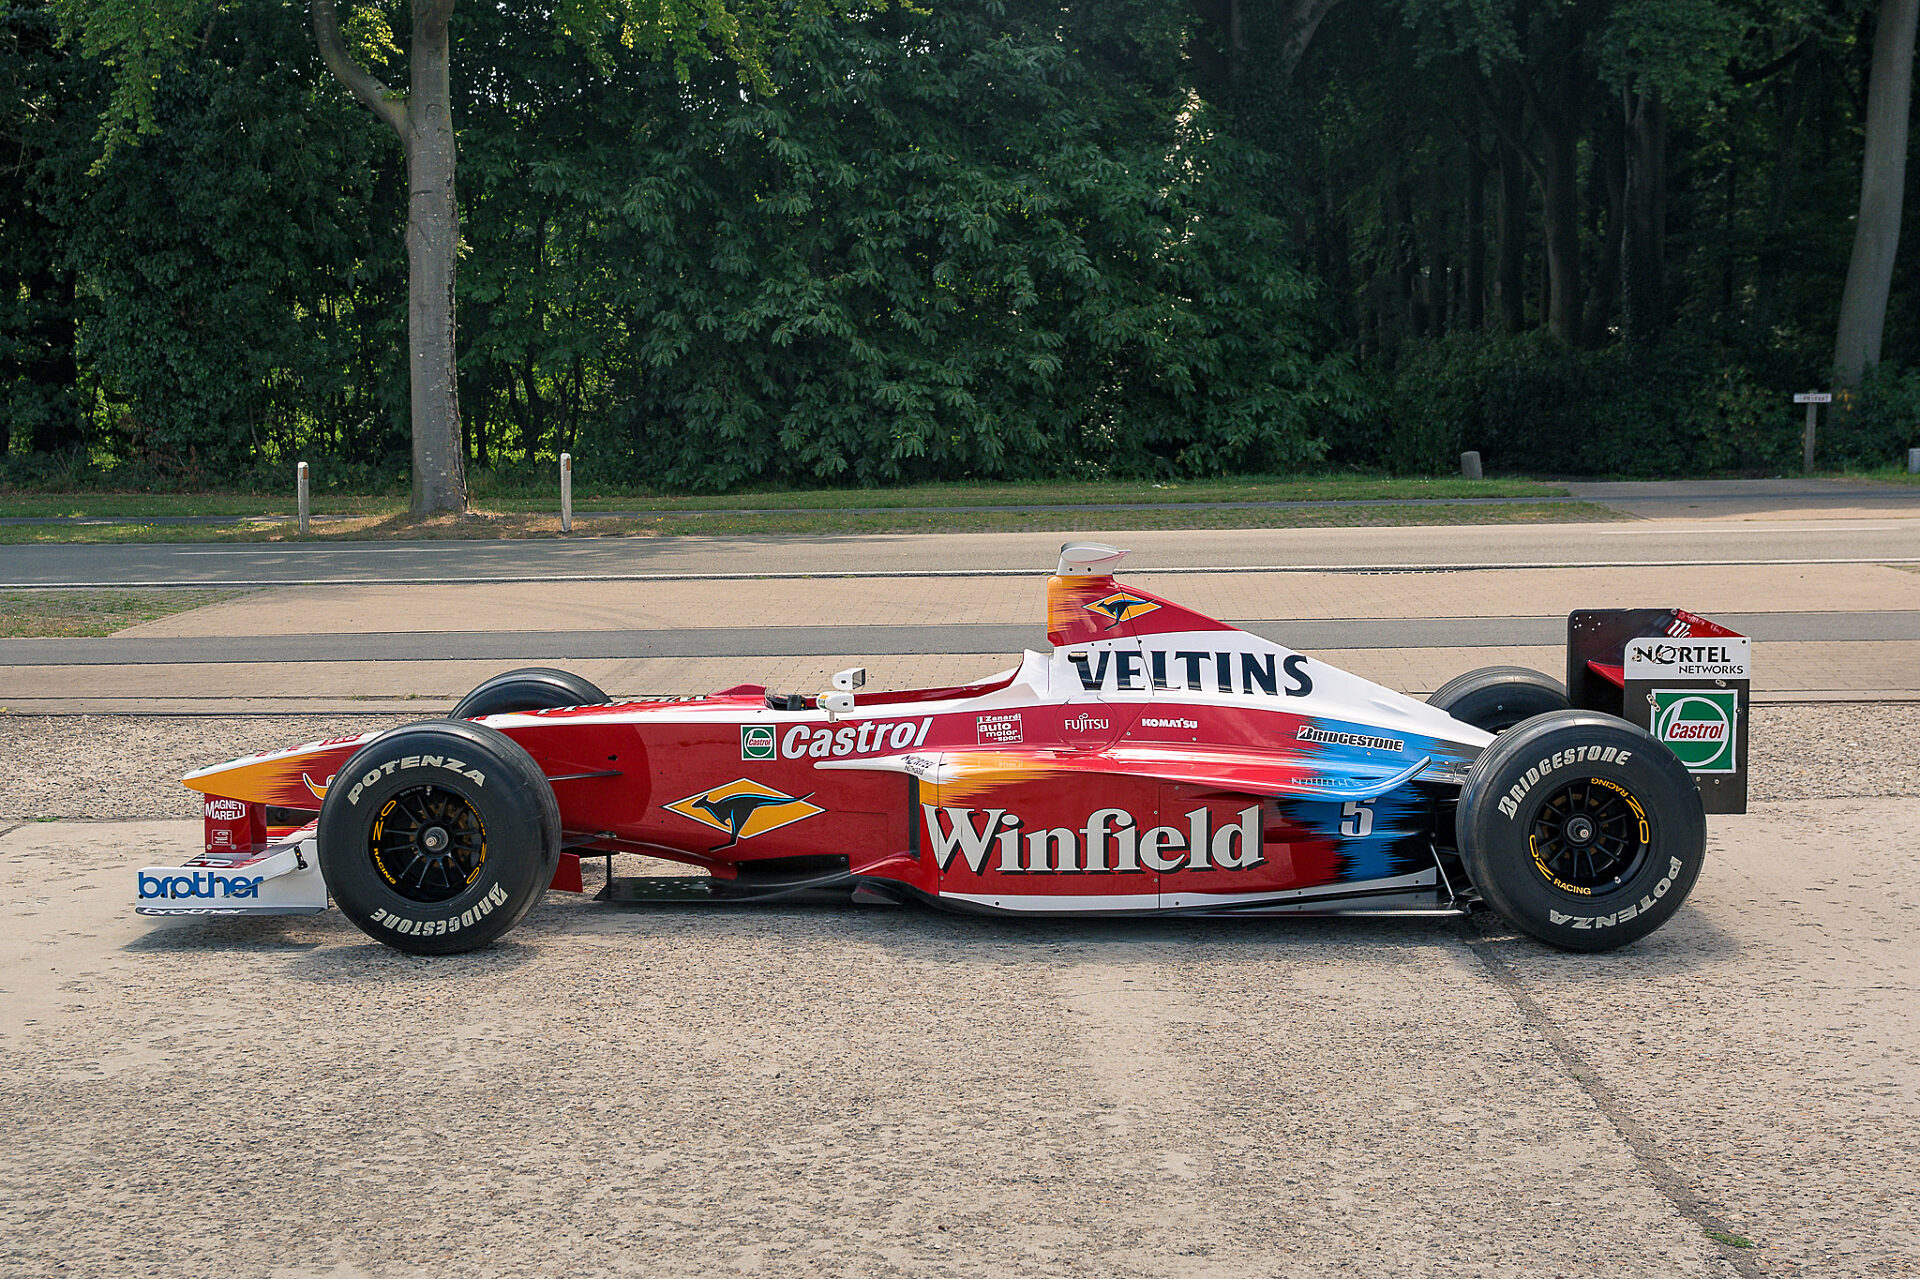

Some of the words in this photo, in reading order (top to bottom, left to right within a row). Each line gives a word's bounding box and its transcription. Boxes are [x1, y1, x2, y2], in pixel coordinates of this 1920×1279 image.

[1637, 644, 1731, 664] NORTEL
[1068, 651, 1313, 697] VELTINS
[1679, 665, 1743, 674] NETWORKS
[980, 722, 1011, 732] auto
[986, 729, 1018, 737] motor
[1065, 713, 1109, 732] FUJITSU
[1142, 718, 1198, 728] KOMATSU
[1669, 723, 1725, 739] Castrol
[749, 738, 771, 747] Castrol
[781, 717, 934, 759] Castrol
[1297, 726, 1403, 751] BRIDGESTONE
[347, 755, 486, 805] POTENZA
[1498, 745, 1632, 820] BRIDGESTONE
[1590, 777, 1629, 797] RACING
[1340, 797, 1377, 837] 5
[923, 803, 1268, 877] Winfield
[374, 848, 397, 884] RACING
[138, 872, 264, 899] brother
[1549, 856, 1683, 929] POTENZA
[1553, 878, 1591, 896] RACING
[370, 882, 508, 936] BRIDGESTONE
